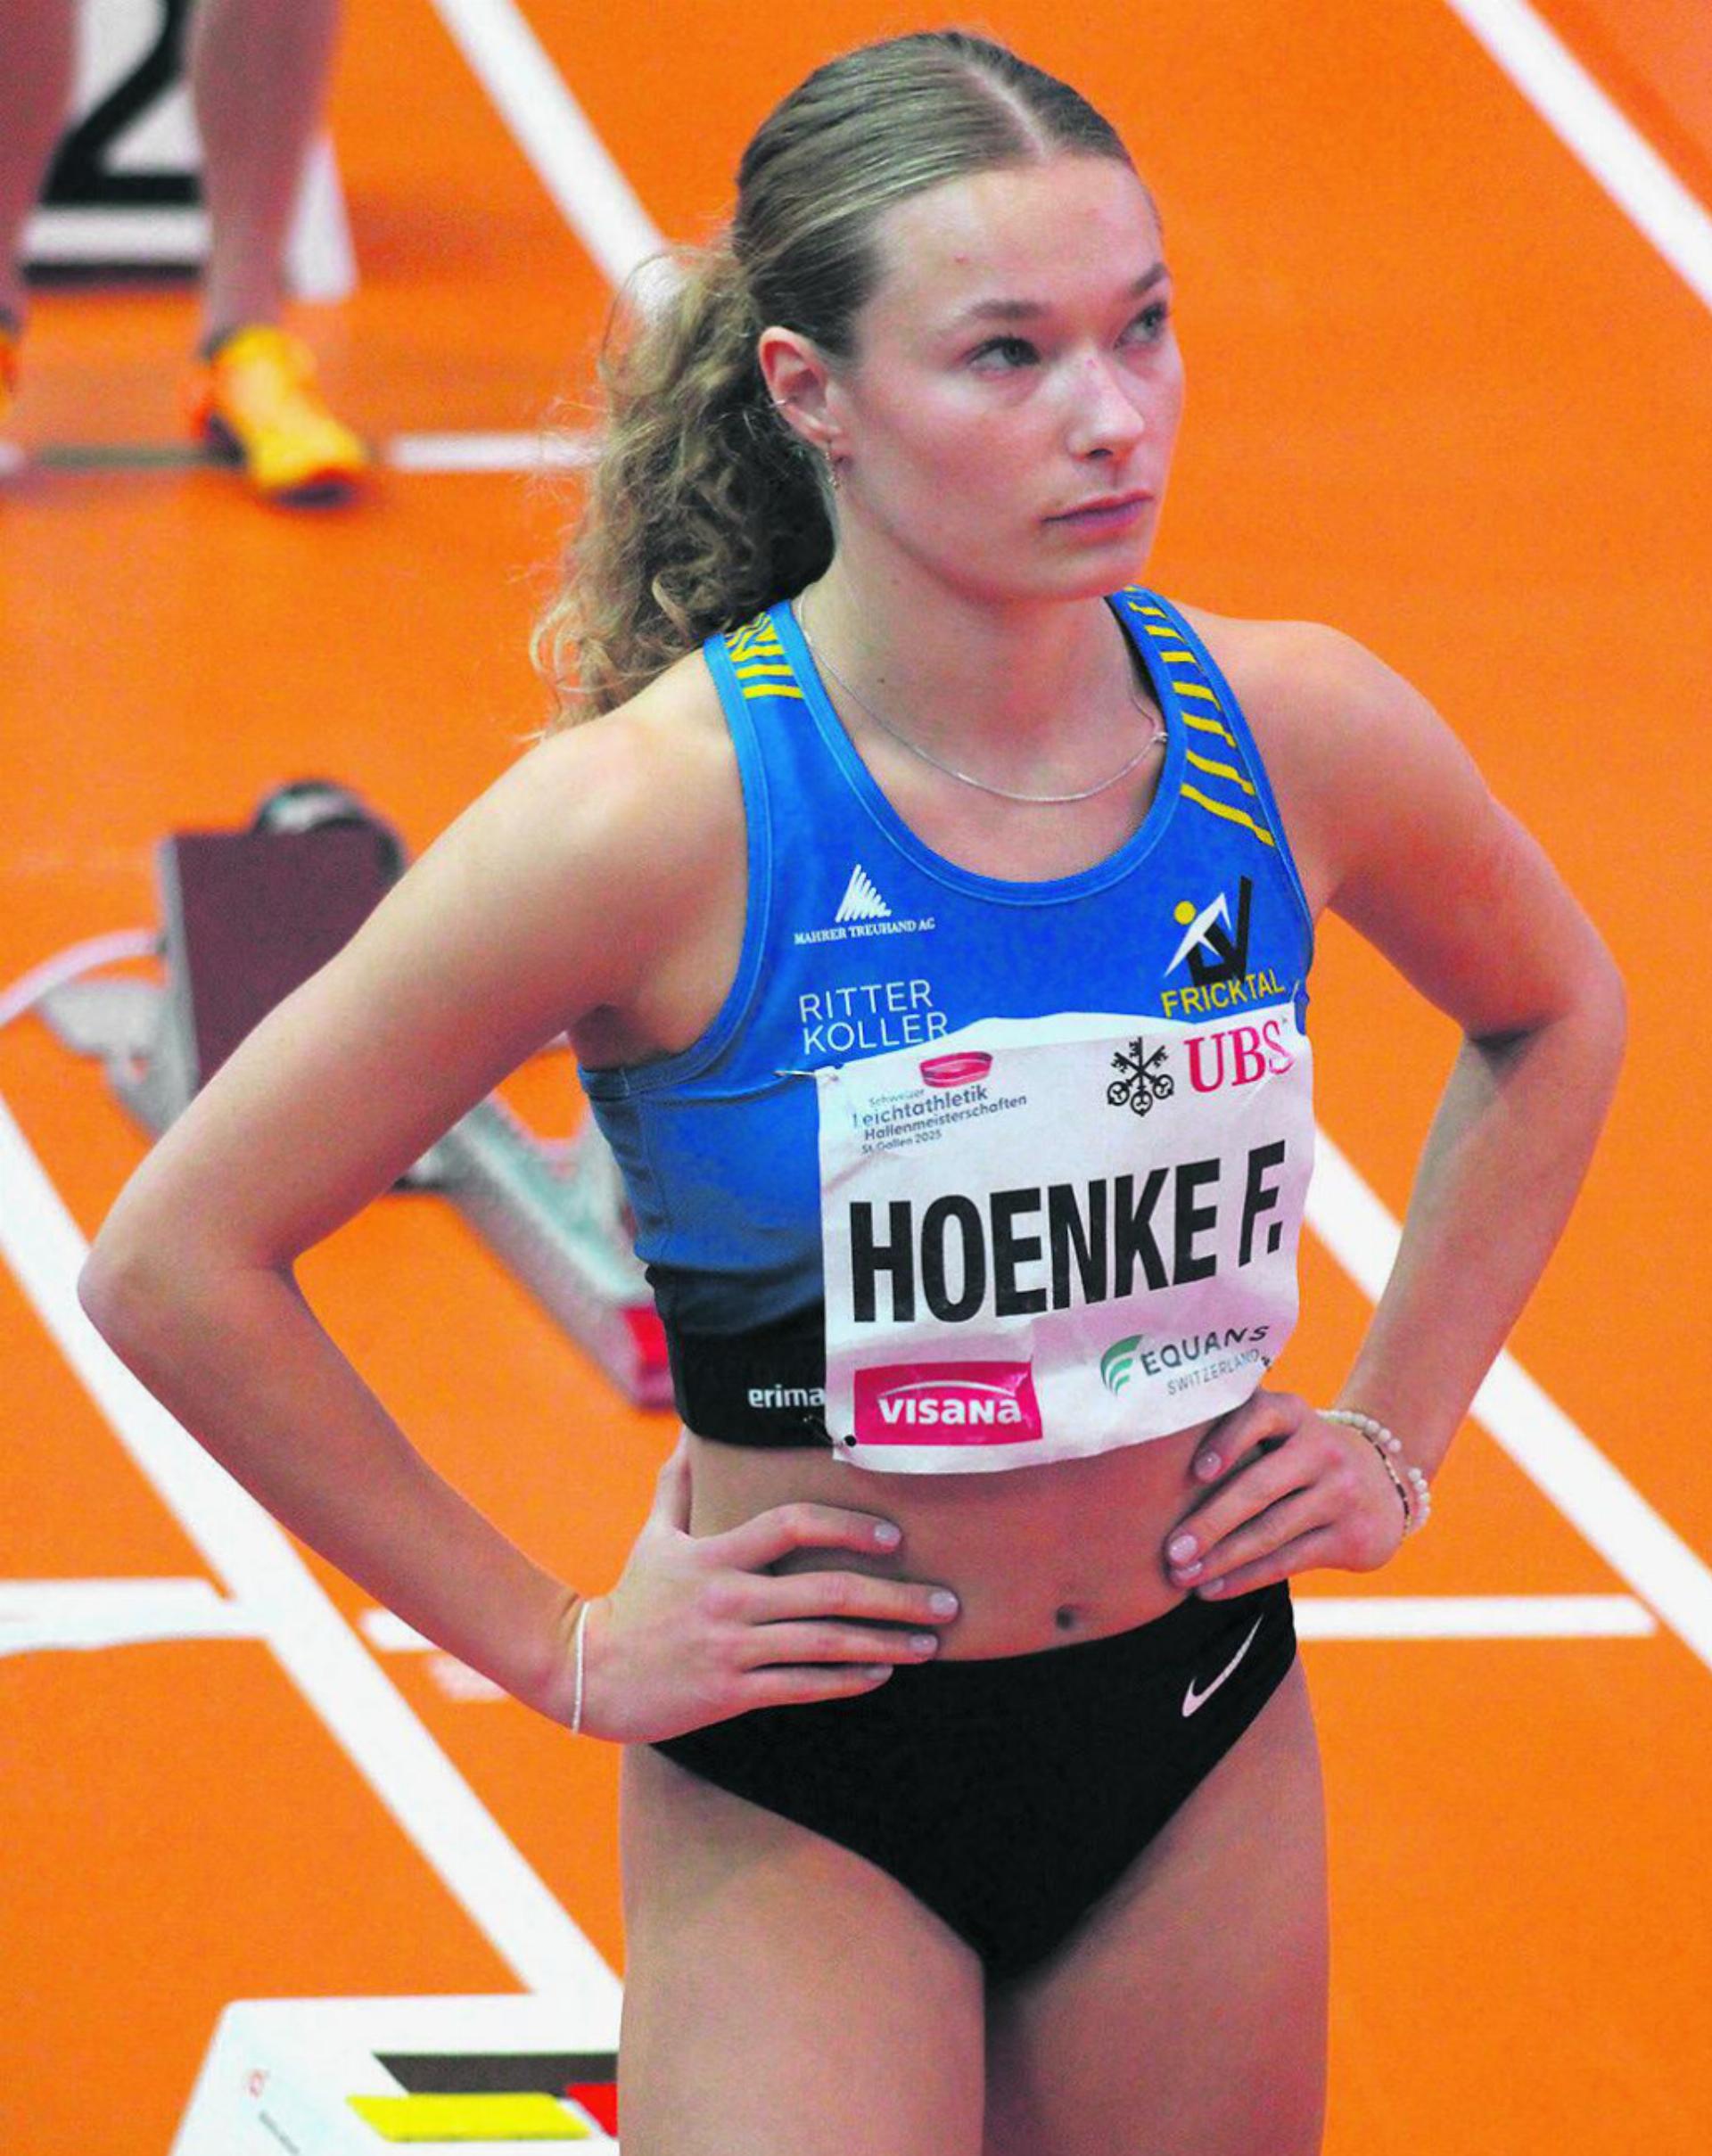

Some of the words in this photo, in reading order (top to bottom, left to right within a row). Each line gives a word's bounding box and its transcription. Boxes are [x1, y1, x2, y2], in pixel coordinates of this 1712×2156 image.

[37, 0, 205, 209] 2
[794, 926, 846, 945] MAHRER
[848, 919, 917, 938] TREUHAND
[918, 917, 935, 930] AG
[799, 979, 933, 1023] RITTER
[1160, 968, 1285, 1017] FRICKTAL
[803, 1011, 947, 1055] KOLLER
[1183, 1020, 1296, 1093] UBS
[864, 1094, 1028, 1141] Hallenmeisterschaften
[877, 1137, 914, 1152] Gallen
[915, 1129, 942, 1143] 2025
[850, 1158, 1220, 1322] HOENKE
[1239, 1140, 1285, 1267] F.
[1140, 1326, 1270, 1376] EQUANS
[1167, 1348, 1260, 1395] SWITZERLAND
[748, 1385, 826, 1408] erima
